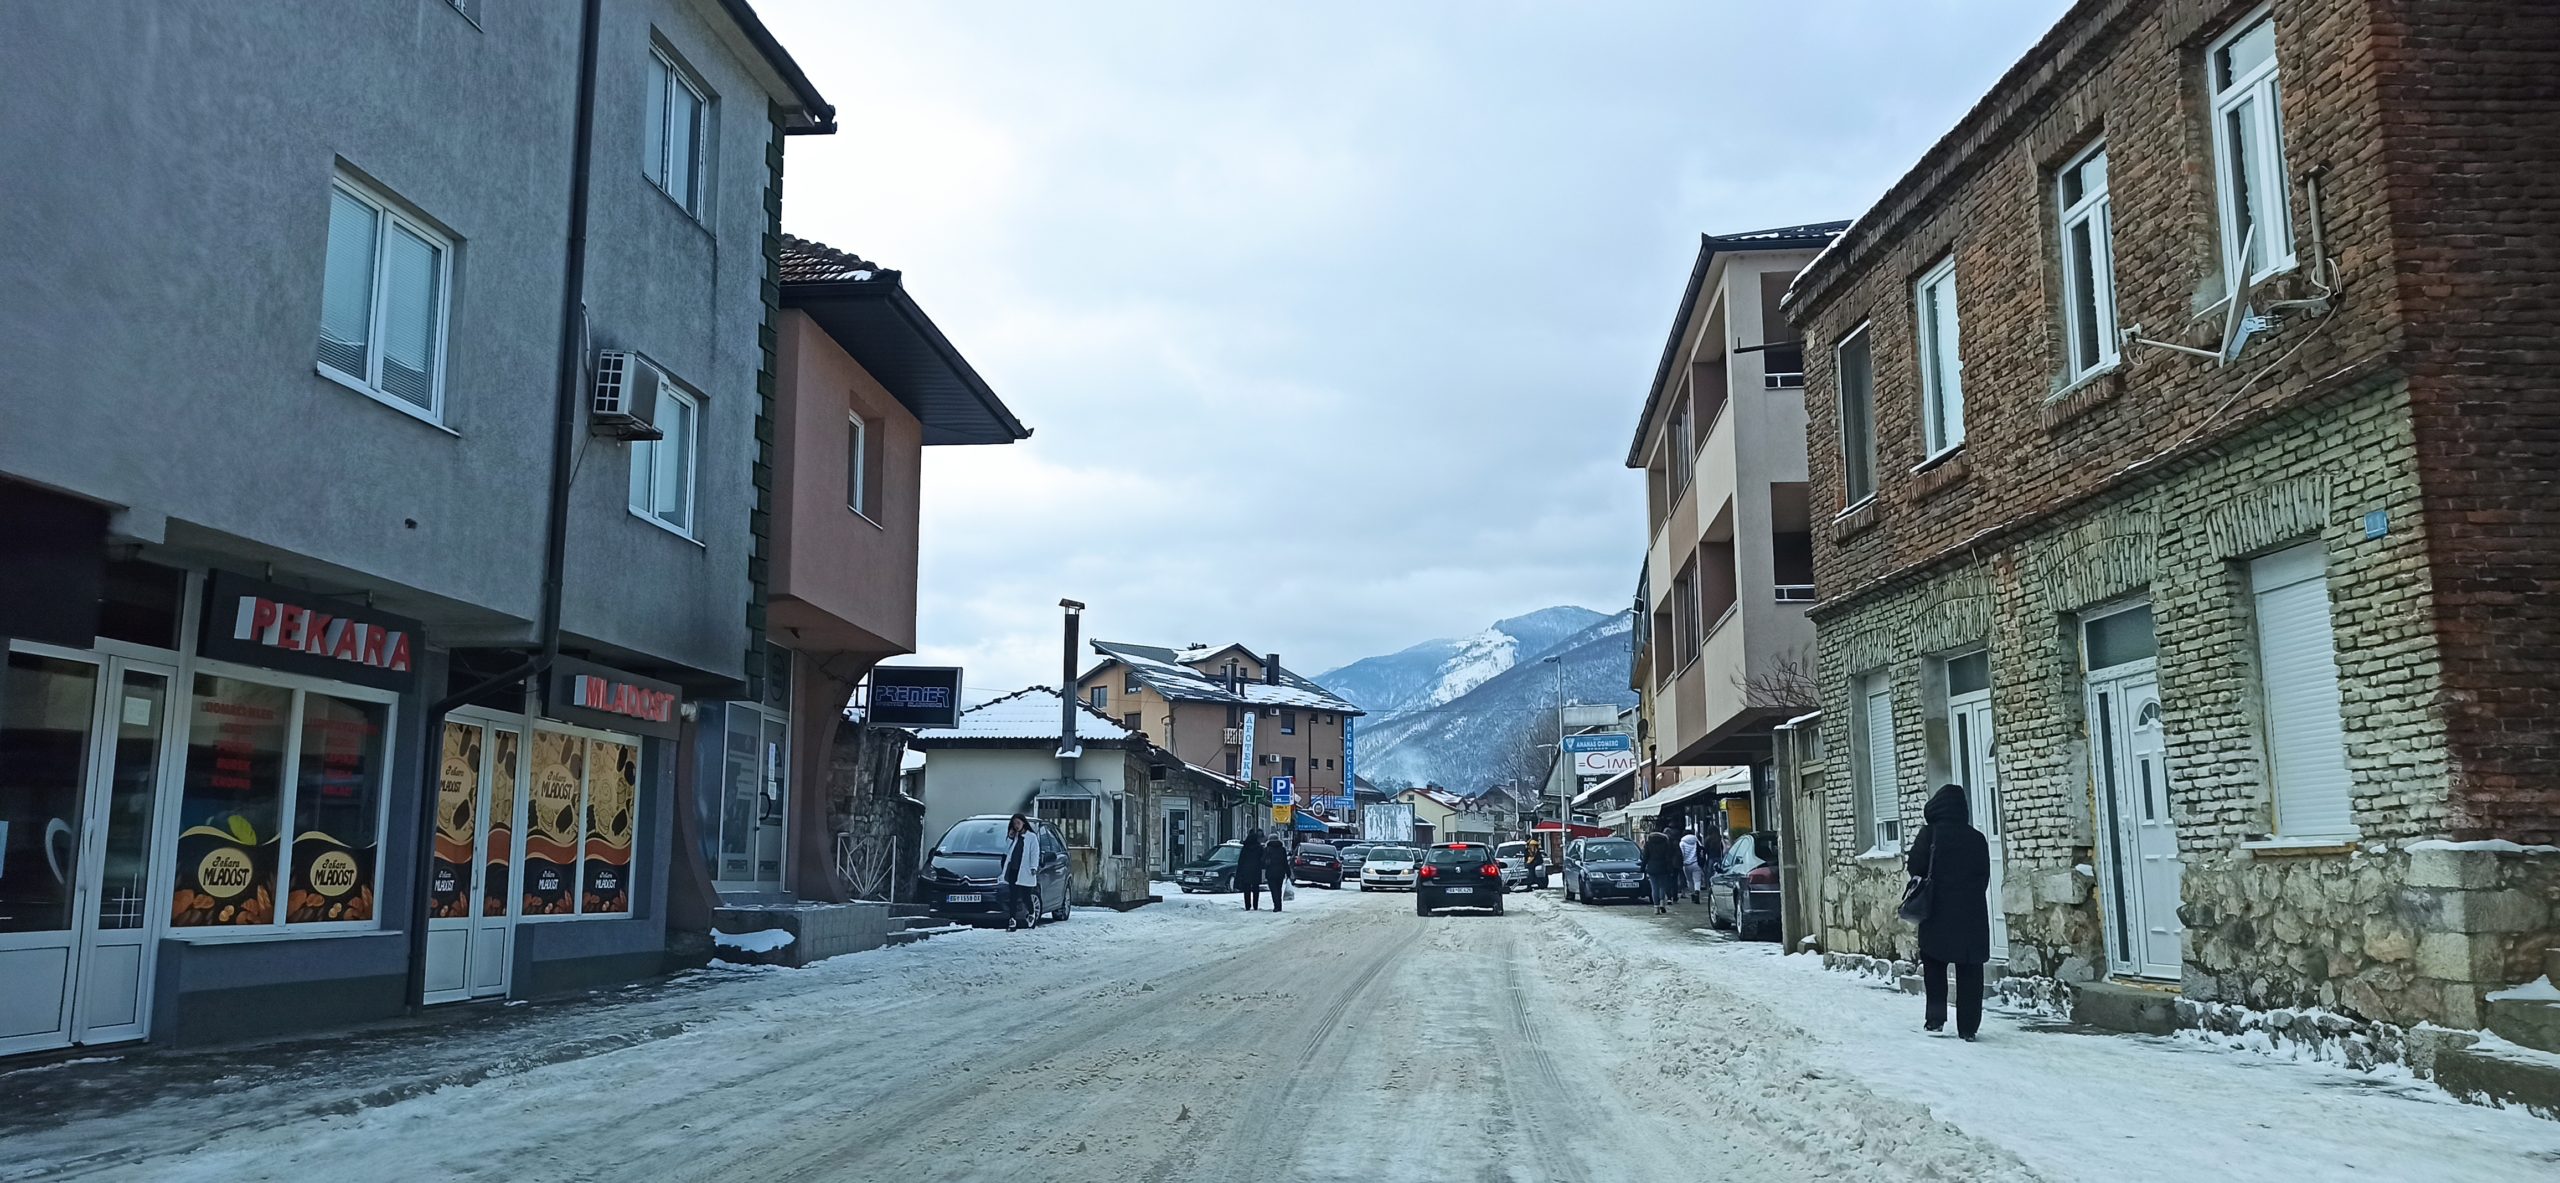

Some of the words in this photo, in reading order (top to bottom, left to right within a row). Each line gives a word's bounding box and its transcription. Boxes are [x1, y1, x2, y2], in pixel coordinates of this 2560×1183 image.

[236, 597, 411, 672] PEKARA
[576, 675, 675, 722] MLADOST
[875, 685, 950, 708] PREMIER
[1243, 716, 1254, 779] APOTEKA
[541, 780, 573, 800] MLADOST
[1276, 779, 1287, 793] P
[203, 867, 250, 887] MLADOST
[314, 869, 355, 886] MLADOST
[434, 879, 455, 892] MLADOST
[538, 878, 559, 890] MLADOST
[595, 878, 617, 889] MLADOST
